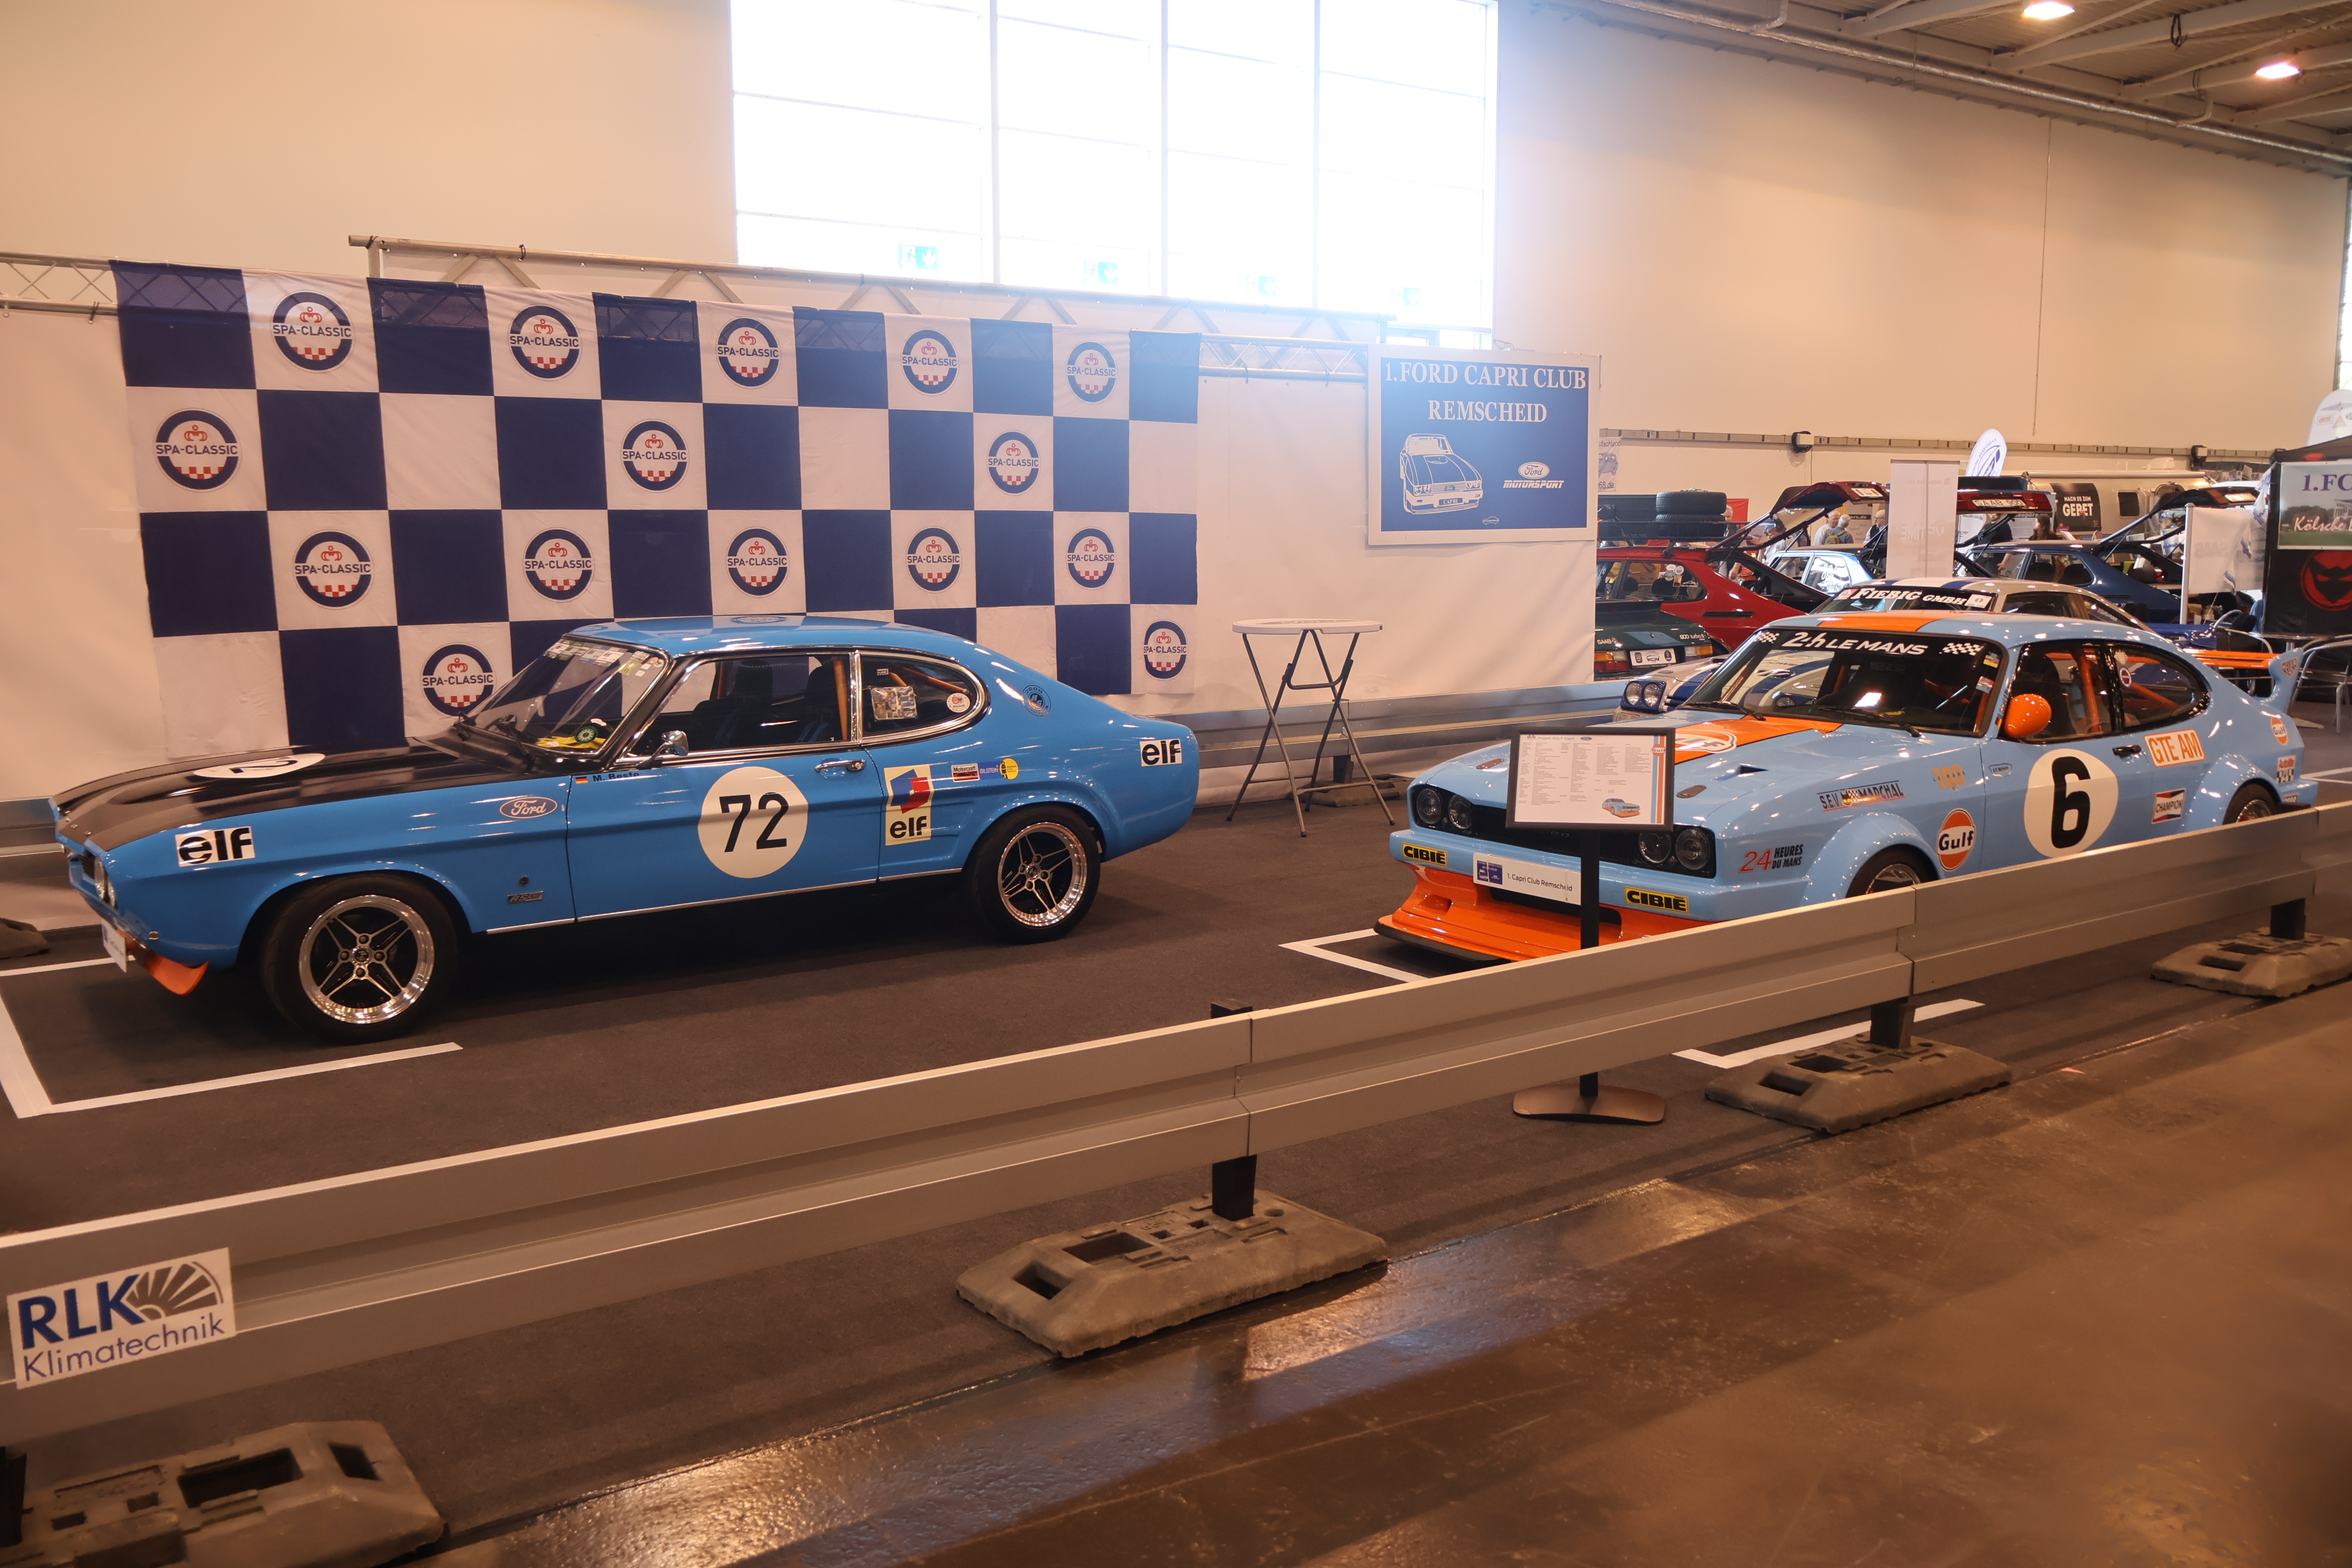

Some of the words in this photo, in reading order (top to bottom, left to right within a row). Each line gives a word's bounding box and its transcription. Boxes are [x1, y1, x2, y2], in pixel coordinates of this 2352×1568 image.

[273, 323, 352, 338] SPA-CLASSIC
[510, 335, 579, 348] SPA-CLASSIC
[717, 346, 779, 359] SPA-CLASSIC
[902, 356, 957, 368] SPA-CLASSIC
[1067, 366, 1115, 378] SPA-CLASSIC
[1465, 365, 1528, 387] CAPRI
[1534, 368, 1586, 388] CLUB
[1428, 400, 1547, 422] REMSCHEID
[156, 444, 238, 456] SPA-CLASSIC
[622, 450, 686, 462] SPA-CLASSIC
[988, 458, 1038, 467] SPA-CLASSIC
[1524, 465, 1543, 476] Ford
[2294, 515, 2347, 532] Kölsche
[727, 556, 788, 568] SPA-CLASSIC
[907, 554, 959, 565] SPA-CLASSIC
[1067, 553, 1114, 563] SPA-CLASSIC
[294, 563, 371, 575] SPA-CLASSIC
[524, 559, 592, 571] SPA-CLASSIC
[1850, 588, 1923, 600] FIEBIG
[1923, 595, 1967, 605] GMBH
[1143, 645, 1186, 654] SPA-CLASSIC
[1825, 639, 1858, 649] LE
[1855, 641, 1929, 655] MANS
[422, 674, 493, 686] SPA-CLASSIC
[2273, 726, 2286, 735] Gulf
[1142, 739, 1181, 766] elf
[1932, 764, 1965, 790] 100
[511, 800, 547, 816] Ford
[2051, 756, 2091, 849] 6
[2156, 801, 2183, 813] CHAMPION
[719, 792, 789, 853] 72
[890, 816, 927, 838] elf
[179, 828, 252, 864] elf
[1939, 831, 1974, 851] Gulf
[1738, 849, 1773, 873] 24
[1774, 844, 1804, 858] HEURES
[1772, 859, 1782, 869] DU
[1783, 857, 1802, 868] MANS
[1512, 874, 1526, 882] Capri
[18, 1274, 146, 1350] RLK
[23, 1312, 225, 1382] Klimatechnik
